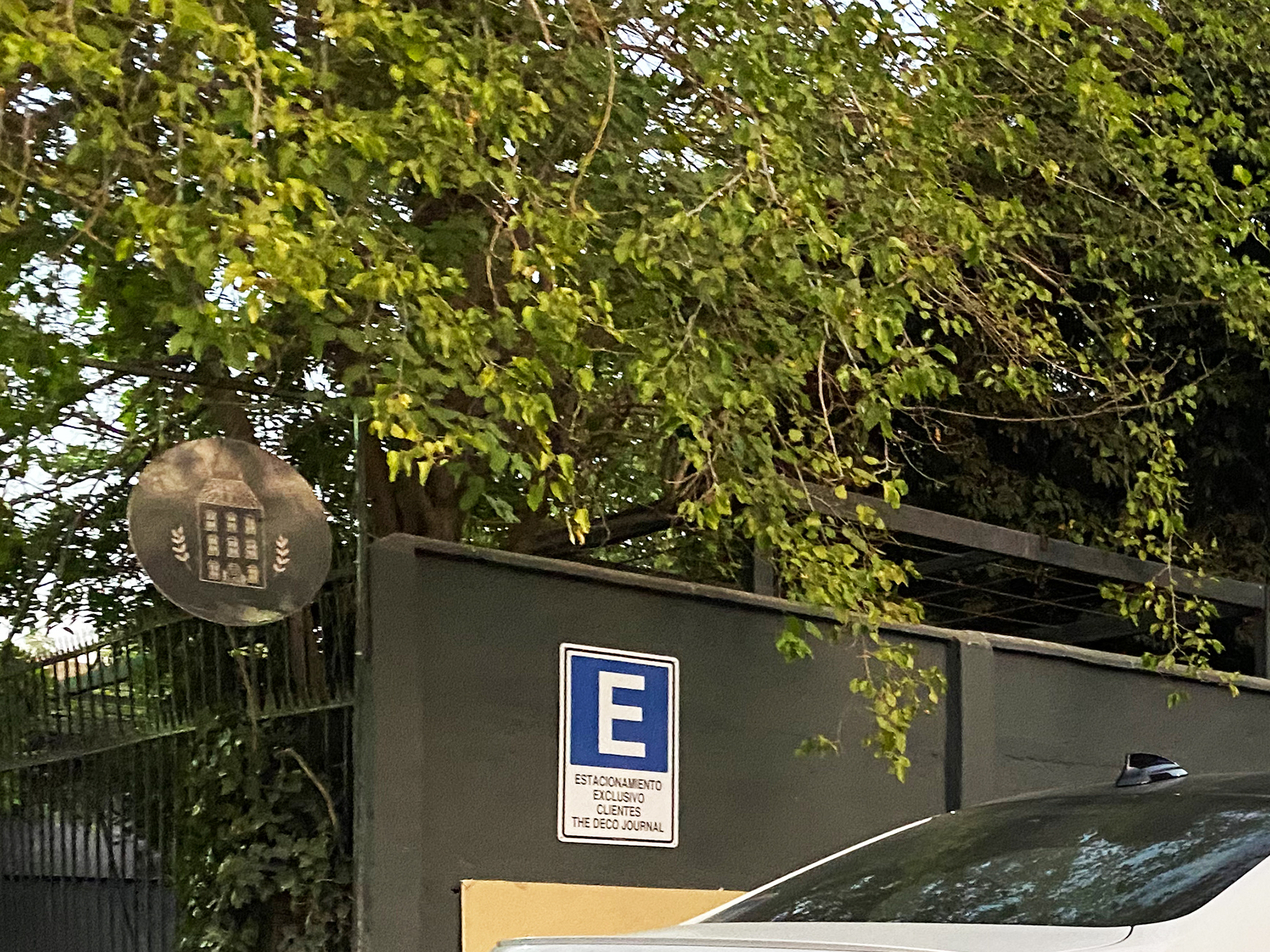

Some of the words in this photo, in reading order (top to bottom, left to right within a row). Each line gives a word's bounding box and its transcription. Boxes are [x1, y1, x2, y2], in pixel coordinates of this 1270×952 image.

[598, 670, 646, 758] E
[574, 773, 663, 791] ESTACIONAMIENTO
[593, 789, 645, 804] EXCLUSIVO
[596, 804, 641, 817] CLIENTES
[571, 816, 591, 829] THE
[593, 818, 620, 831] DECO
[621, 819, 664, 833] JOURNAL
